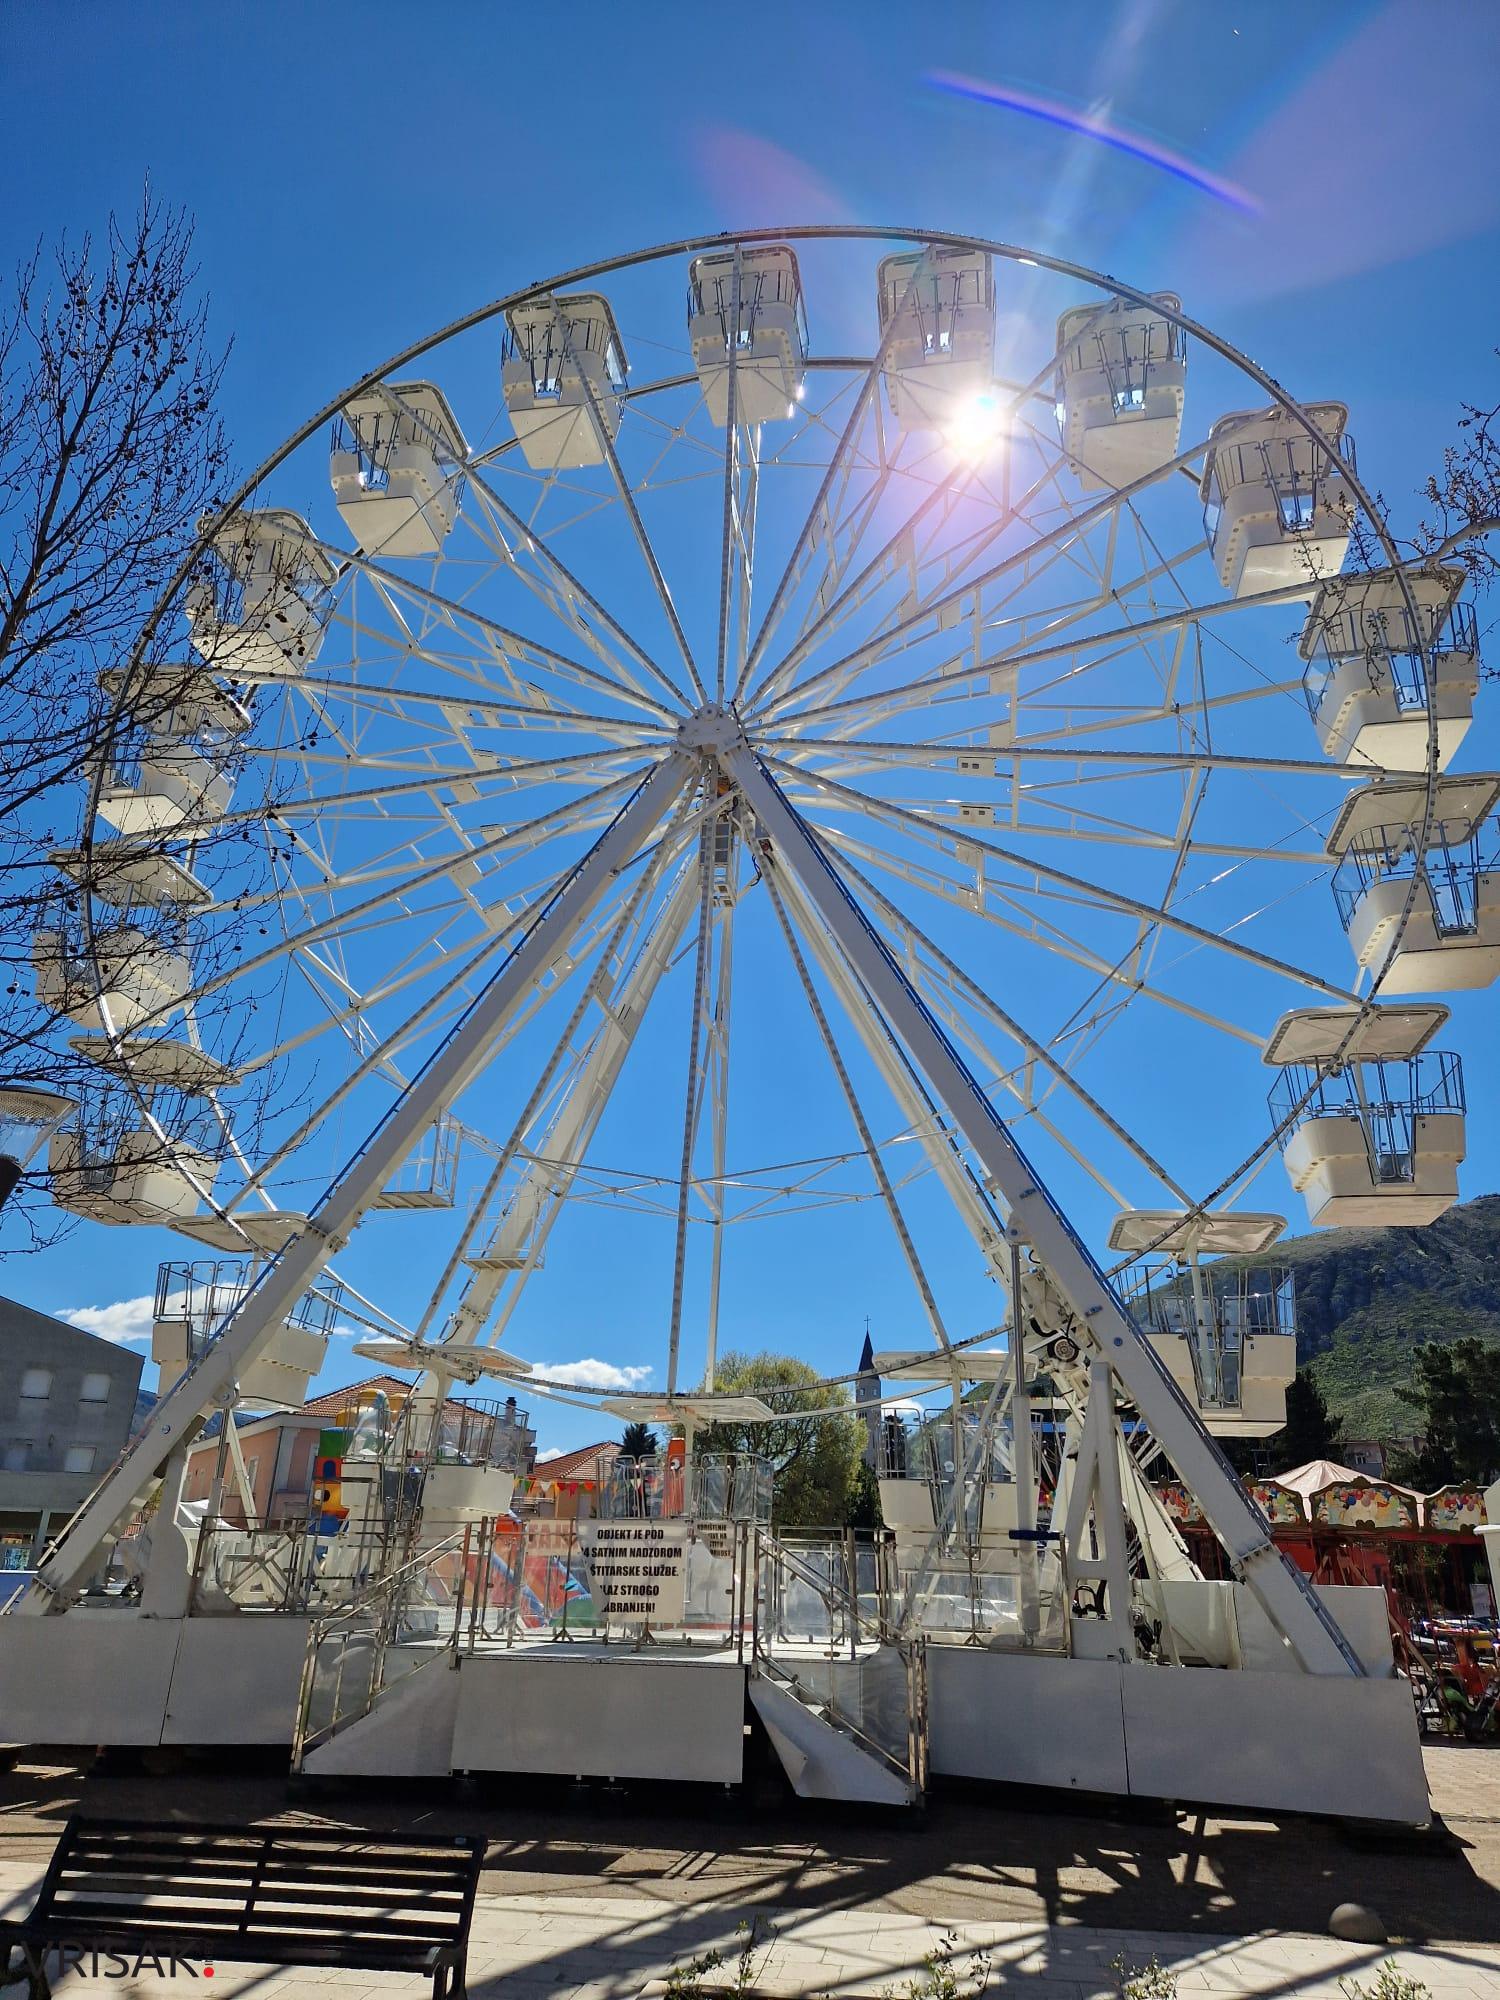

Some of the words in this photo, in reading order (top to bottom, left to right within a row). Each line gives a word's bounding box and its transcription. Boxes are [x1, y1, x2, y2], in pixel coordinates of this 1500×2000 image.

[597, 1529, 631, 1540] OBJEKT
[633, 1529, 643, 1540] JE
[644, 1529, 664, 1540] POD
[591, 1547, 627, 1558] SATNIM
[629, 1547, 682, 1558] NADZOROM
[590, 1564, 640, 1577] ŠTITARSKE
[642, 1564, 679, 1577] SLUŽBE.
[599, 1585, 618, 1596] LAZ
[620, 1585, 660, 1596] STROGO
